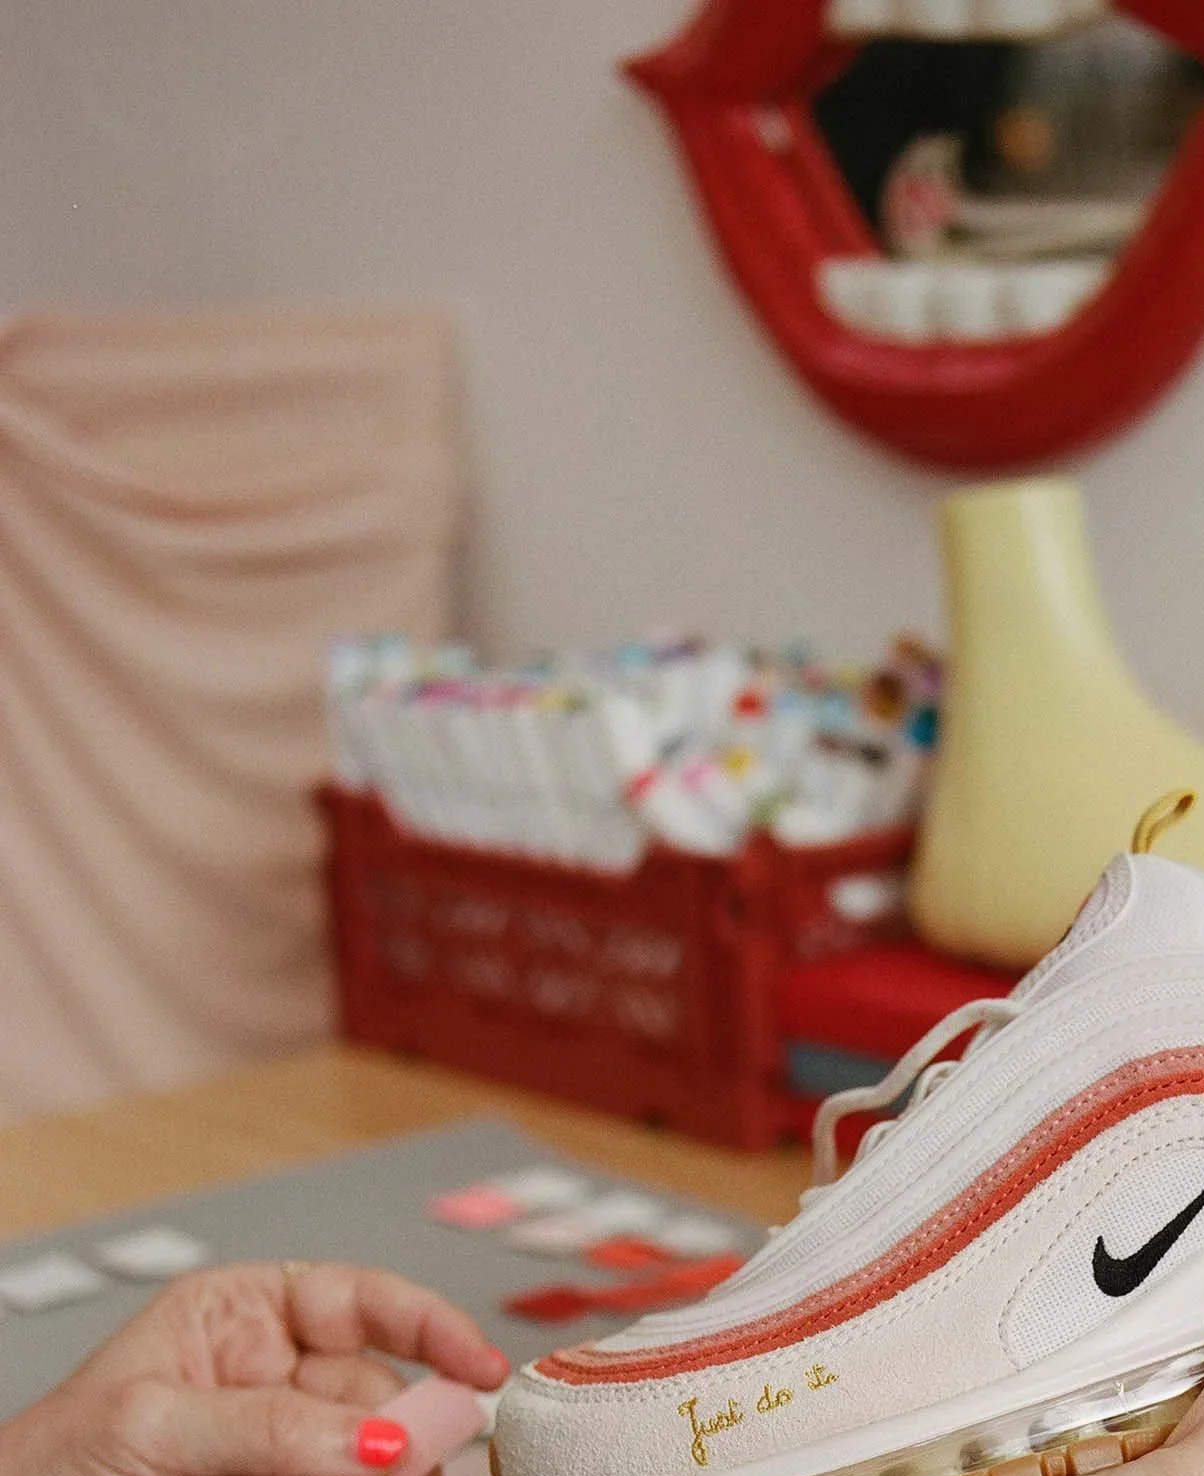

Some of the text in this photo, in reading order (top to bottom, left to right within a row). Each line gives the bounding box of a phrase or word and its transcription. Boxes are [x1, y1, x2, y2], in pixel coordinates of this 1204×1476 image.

[676, 1363, 840, 1467] Just do it
